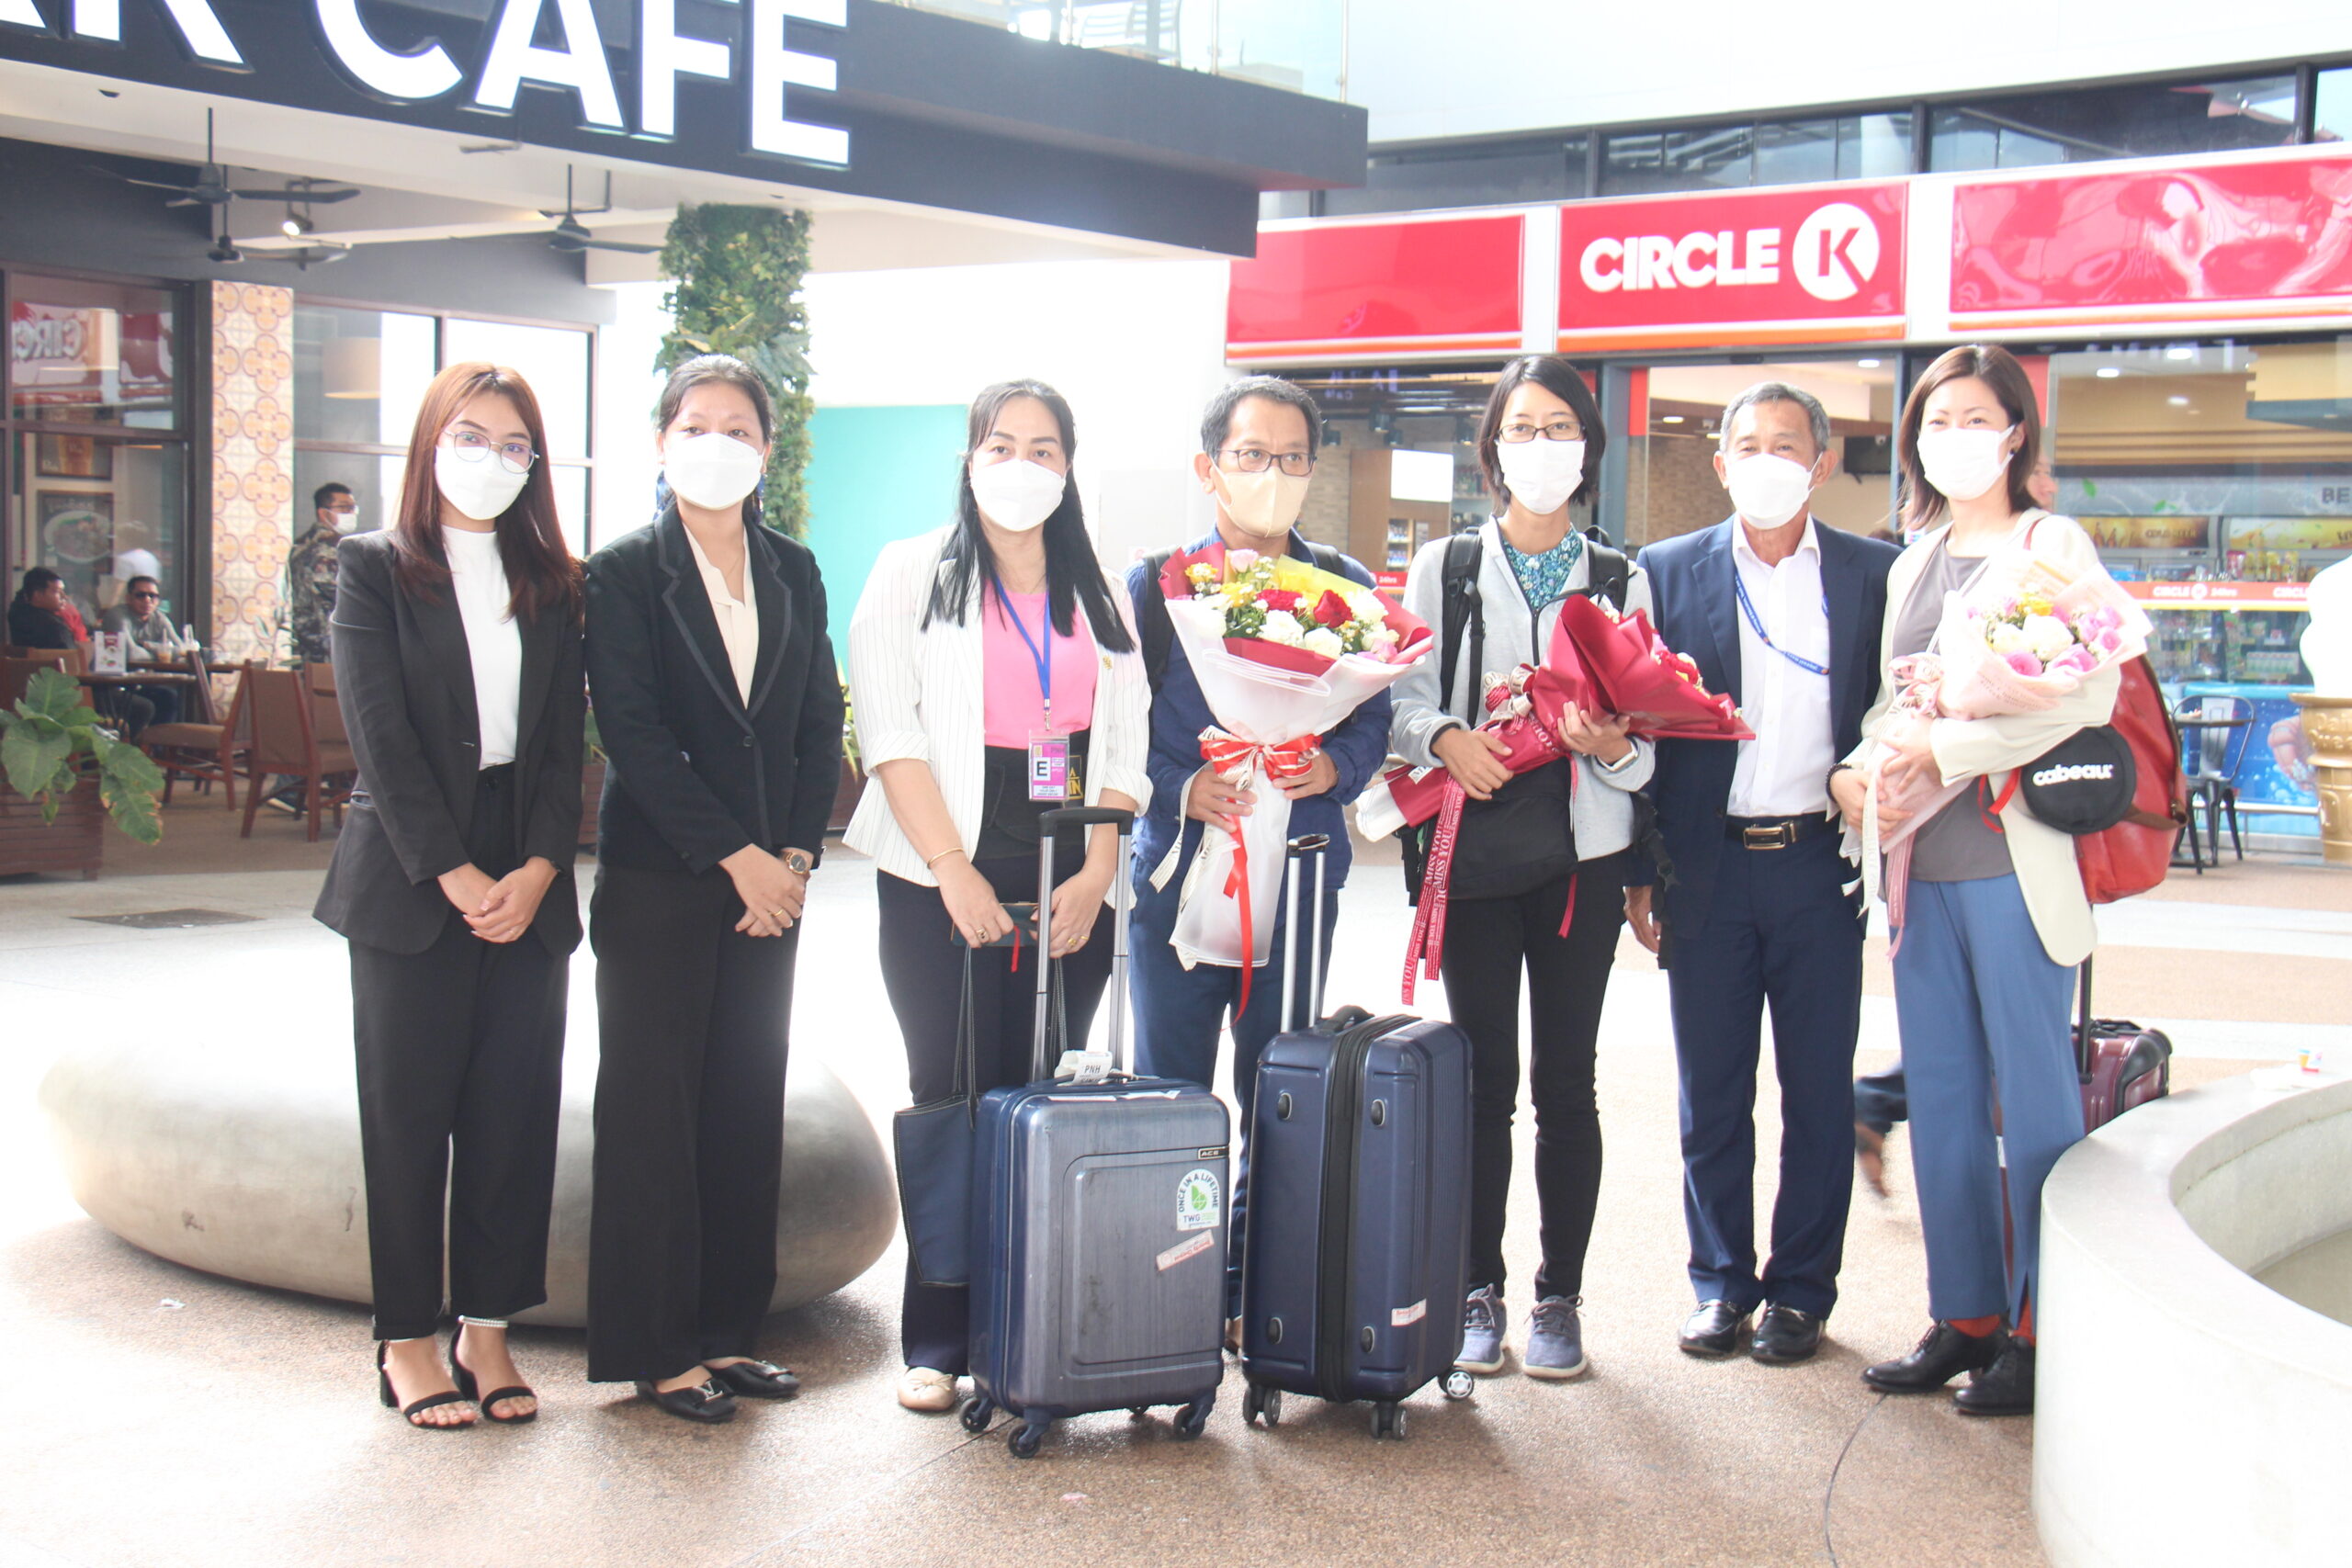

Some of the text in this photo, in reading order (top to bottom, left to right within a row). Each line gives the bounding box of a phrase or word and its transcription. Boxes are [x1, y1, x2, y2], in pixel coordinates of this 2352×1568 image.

[1579, 228, 1781, 293] CIRCLE
[2273, 587, 2309, 599] CIRCL
[1036, 761, 1048, 776] E
[2032, 764, 2112, 787] cabeau
[1438, 829, 1453, 856] YOU
[1433, 858, 1446, 889] MISS
[1403, 960, 1415, 987] YOU
[1085, 1066, 1102, 1074] PNH
[1178, 1173, 1219, 1213] ONCE IN A LIFETIME
[1183, 1213, 1201, 1223] TWG
